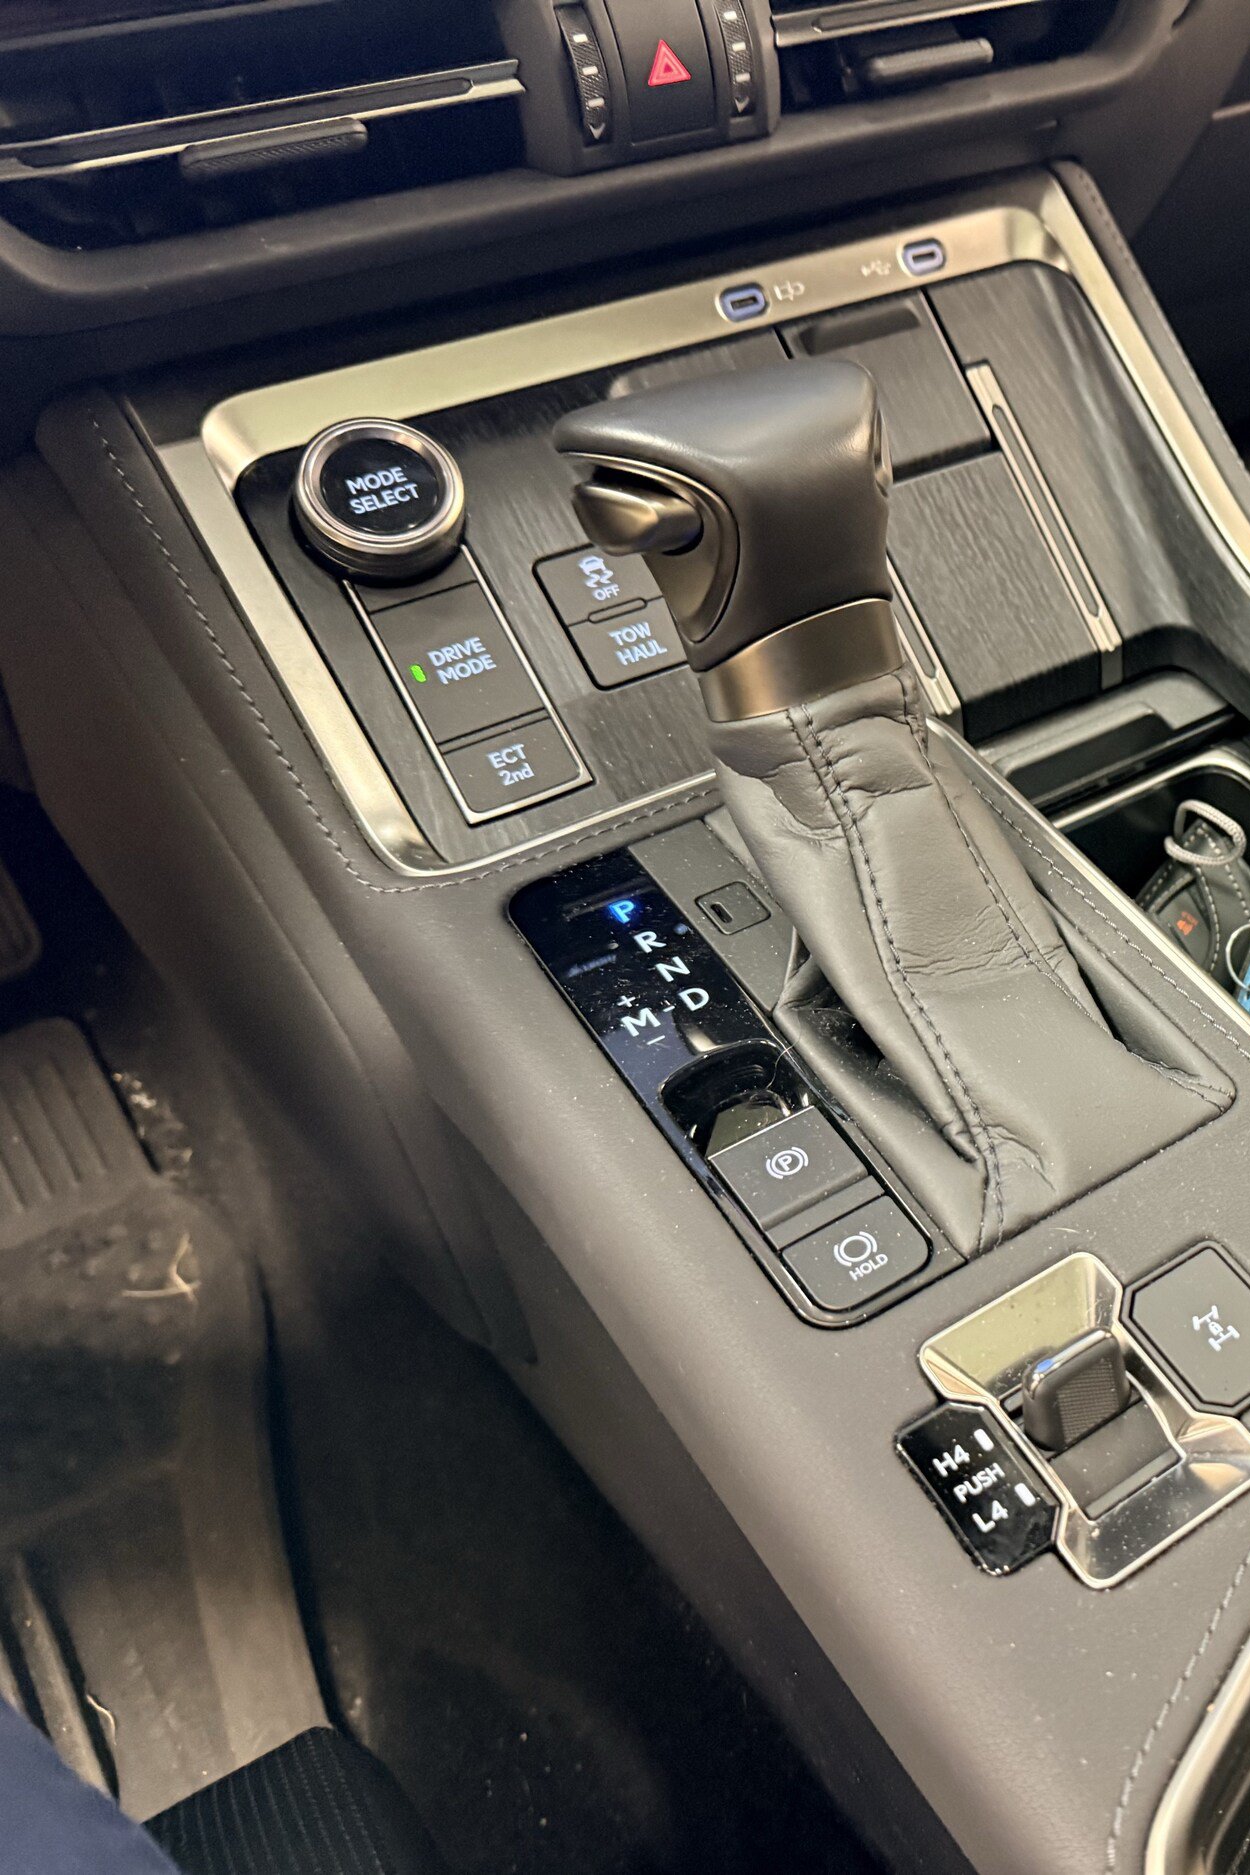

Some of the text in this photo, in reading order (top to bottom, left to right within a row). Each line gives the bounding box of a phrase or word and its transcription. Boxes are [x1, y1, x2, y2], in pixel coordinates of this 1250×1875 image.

[347, 466, 407, 494] MODE
[349, 483, 420, 514] SELECT
[593, 586, 620, 601] OFF
[609, 622, 651, 646] TOW
[427, 637, 486, 667] DRIVE
[616, 640, 667, 665] HAUL
[436, 654, 496, 685] MODE
[488, 744, 526, 769] ECT
[500, 763, 535, 786] 2nd
[609, 900, 635, 924] P
[633, 930, 667, 954] R
[655, 956, 690, 983] N
[678, 987, 709, 1011] D
[620, 1007, 661, 1037] M
[778, 1155, 792, 1171] P
[850, 1254, 888, 1281] HOLD
[932, 1444, 970, 1477] H4
[953, 1462, 1005, 1502] PUSH
[972, 1500, 1008, 1533] L4
